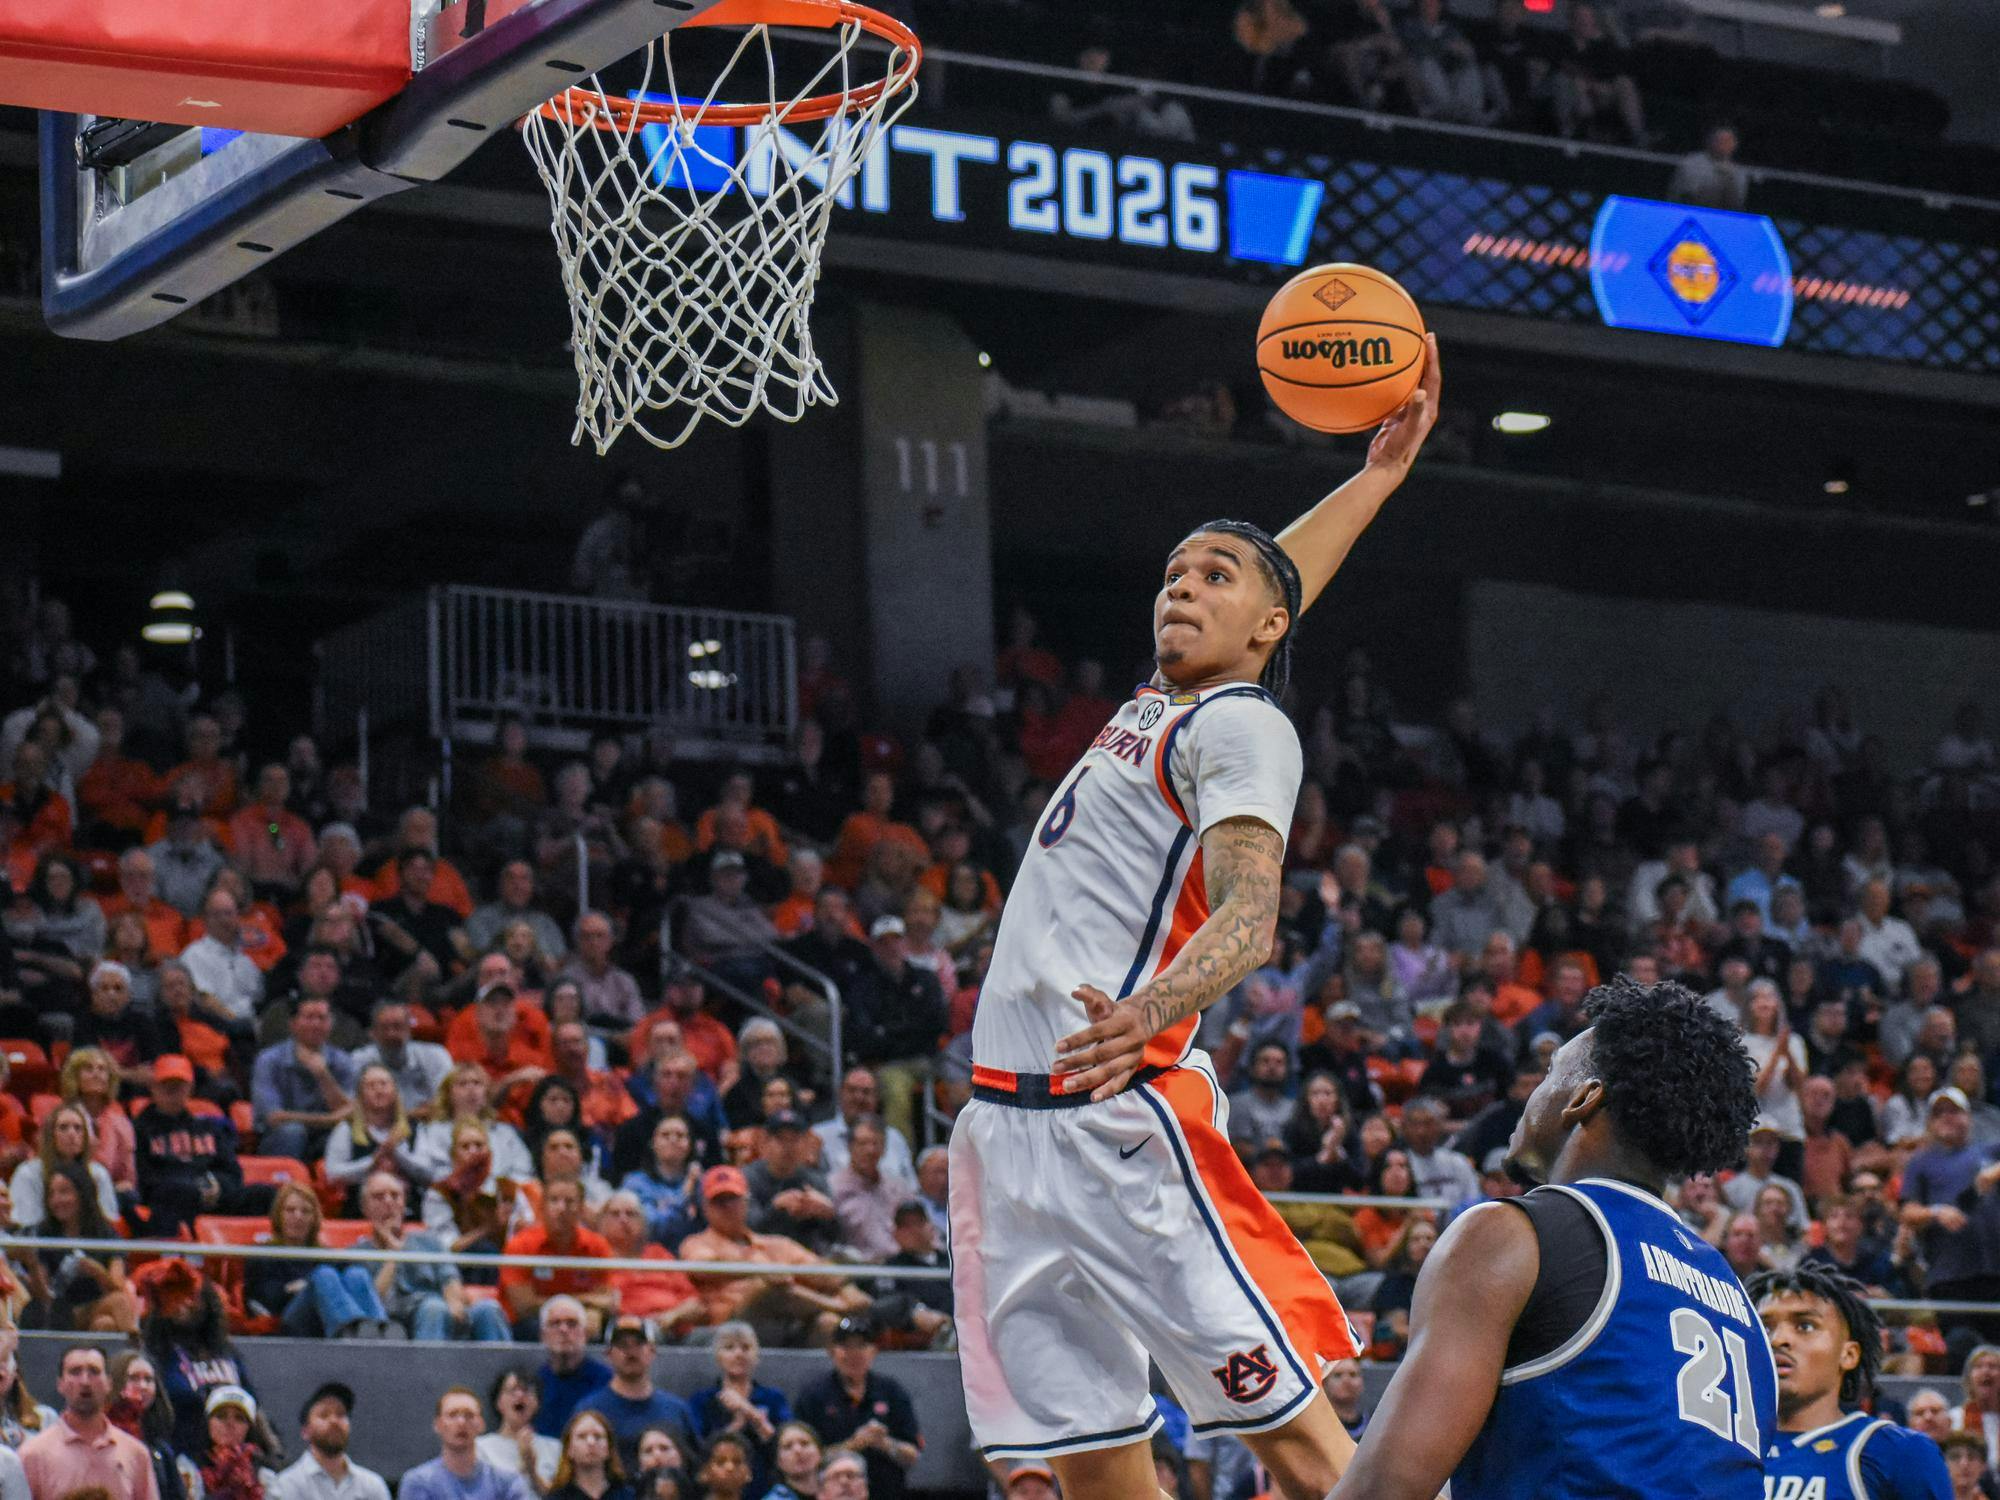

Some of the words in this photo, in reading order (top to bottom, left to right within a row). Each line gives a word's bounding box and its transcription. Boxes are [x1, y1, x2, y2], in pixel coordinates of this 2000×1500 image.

[743, 117, 1000, 222] NIT
[1007, 140, 1221, 252] 2026
[1282, 336, 1394, 369] Wilson
[895, 437, 969, 497] 111
[1140, 701, 1164, 730] SEC
[1038, 765, 1092, 849] 6
[1669, 1307, 1761, 1459] 21
